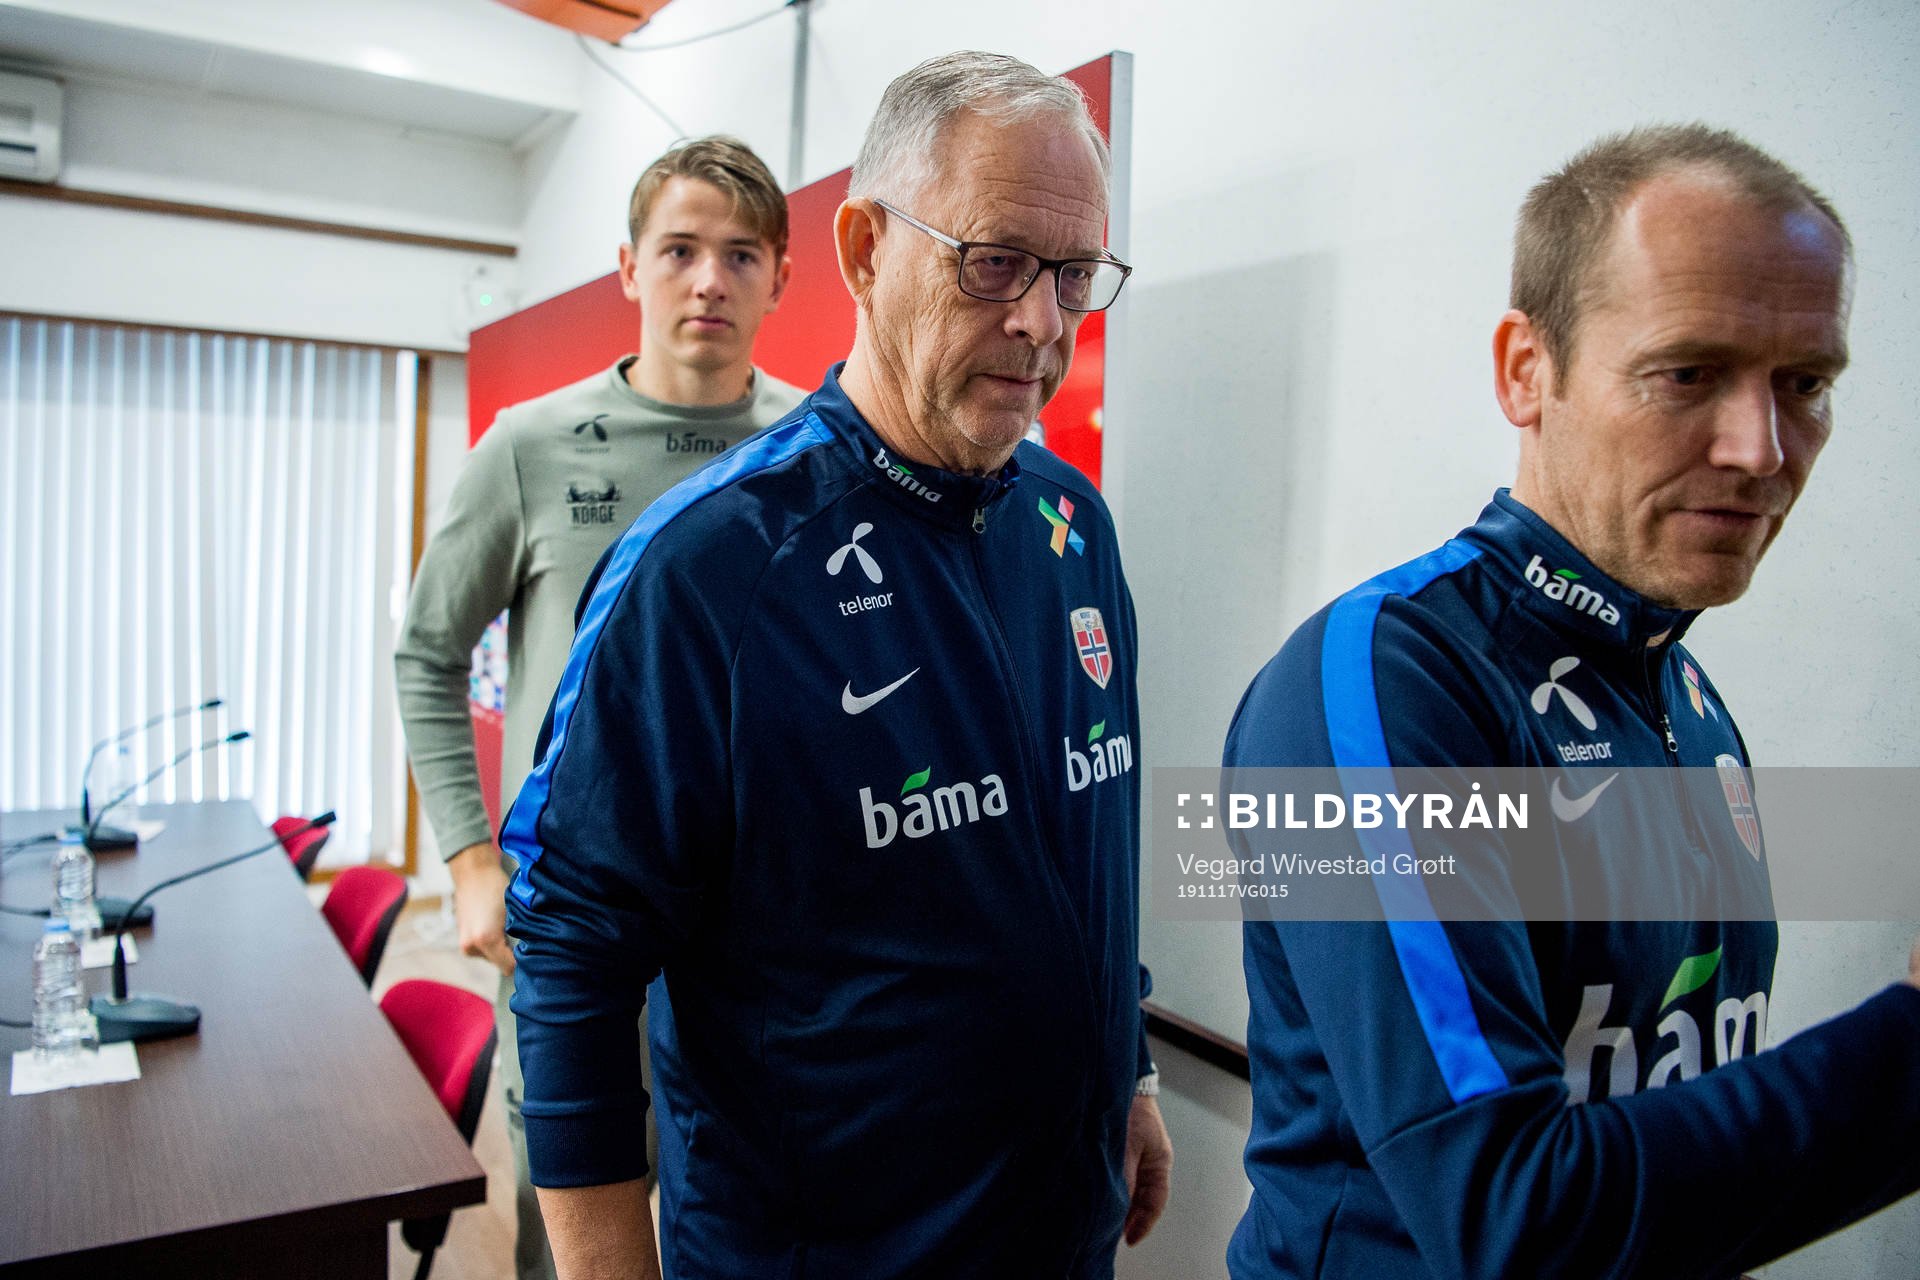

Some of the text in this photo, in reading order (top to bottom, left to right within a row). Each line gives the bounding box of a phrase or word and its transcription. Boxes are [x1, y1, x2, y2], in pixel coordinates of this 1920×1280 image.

[666, 432, 729, 454] bama
[873, 447, 943, 503] bama
[572, 505, 615, 523] NORGE
[838, 591, 893, 616] telenor
[1524, 555, 1620, 626] bama
[1557, 741, 1612, 762] telenor
[859, 774, 1008, 848] bama
[1563, 983, 1768, 1106] bam
